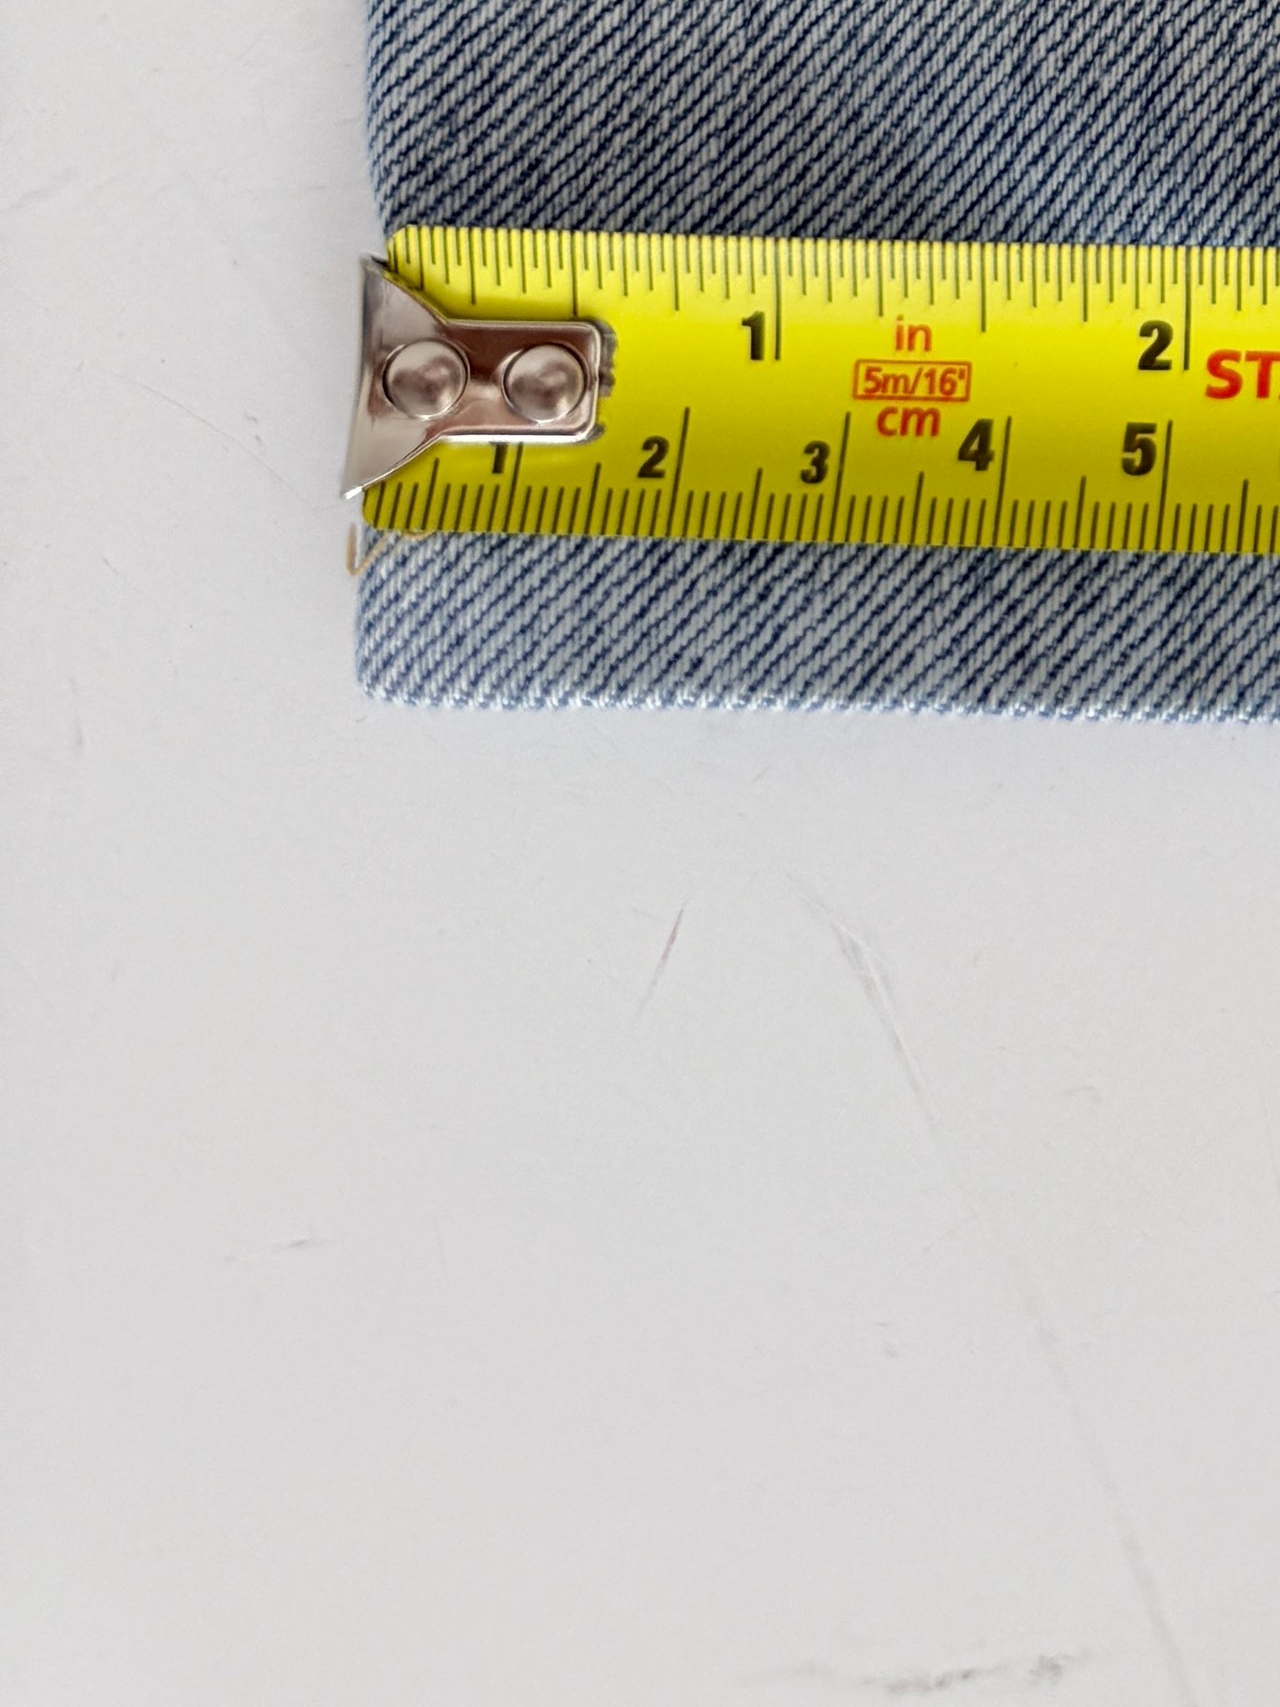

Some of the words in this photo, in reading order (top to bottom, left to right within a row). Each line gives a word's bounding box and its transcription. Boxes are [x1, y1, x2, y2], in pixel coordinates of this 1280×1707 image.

[741, 311, 765, 360] 1
[895, 315, 932, 352] in
[1137, 320, 1174, 372] 2
[877, 405, 940, 437] cm
[638, 435, 670, 479] 2
[801, 440, 830, 484] 3
[957, 419, 995, 472] 4
[1121, 422, 1157, 477] 5
